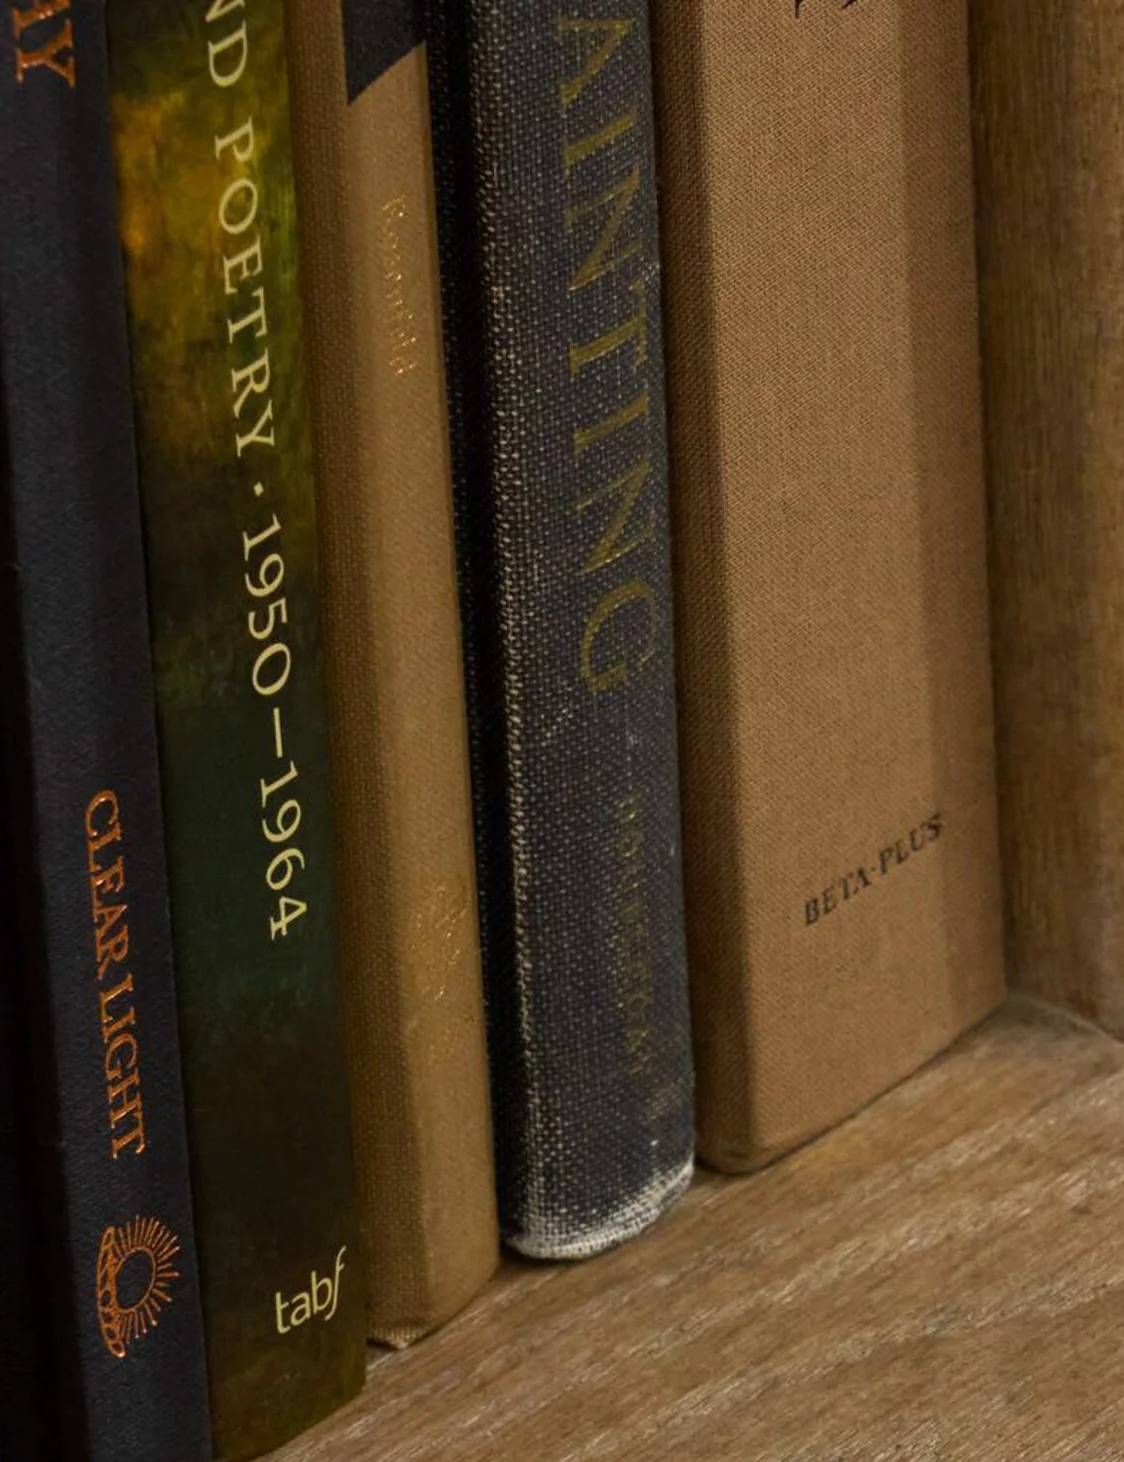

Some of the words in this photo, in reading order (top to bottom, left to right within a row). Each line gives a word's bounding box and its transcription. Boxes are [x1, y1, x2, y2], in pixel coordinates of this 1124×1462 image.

[214, 116, 276, 458] POETRY
[84, 789, 134, 980] CLEAR
[100, 979, 148, 1160] LIGHT
[275, 1245, 347, 1334] tabf
